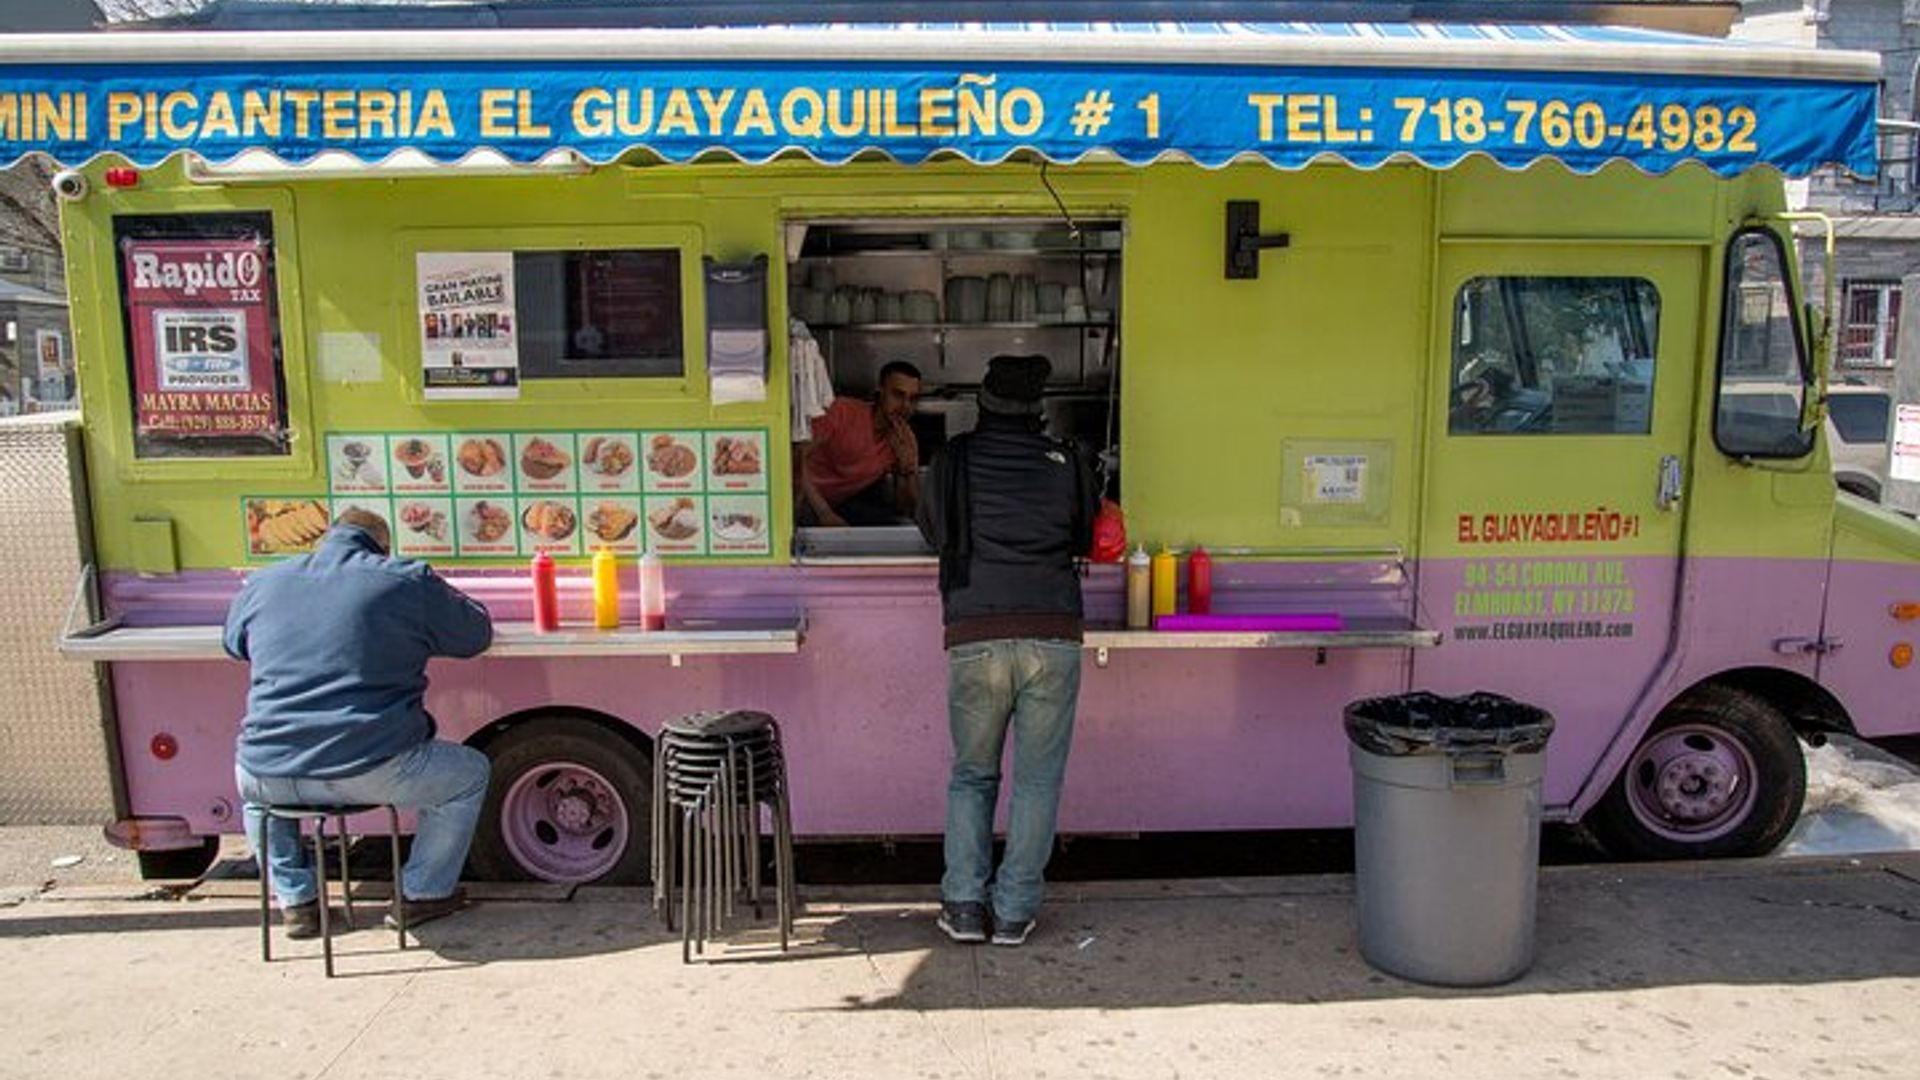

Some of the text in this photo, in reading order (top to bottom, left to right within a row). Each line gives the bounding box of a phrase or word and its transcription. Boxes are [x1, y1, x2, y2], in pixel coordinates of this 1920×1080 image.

[107, 89, 455, 141] PICANTERIA
[480, 88, 551, 138] EL
[572, 73, 1045, 139] GUAYAQUILEÑO
[1070, 90, 1114, 136] #
[1137, 92, 1161, 139] 1
[1248, 93, 1374, 142] TEL:
[1393, 97, 1758, 152] 718-760-4982
[229, 289, 262, 301] TAX
[426, 284, 505, 306] BAILABLE
[164, 325, 238, 353] IRS
[168, 374, 240, 384] PROVIDER
[142, 392, 272, 411] MAYRA MACIAS
[1458, 514, 1478, 543] EL
[1482, 506, 1620, 542] GUAYAQUILEÑO
[1521, 561, 1588, 585] CORONA
[1553, 590, 1576, 614] NY
